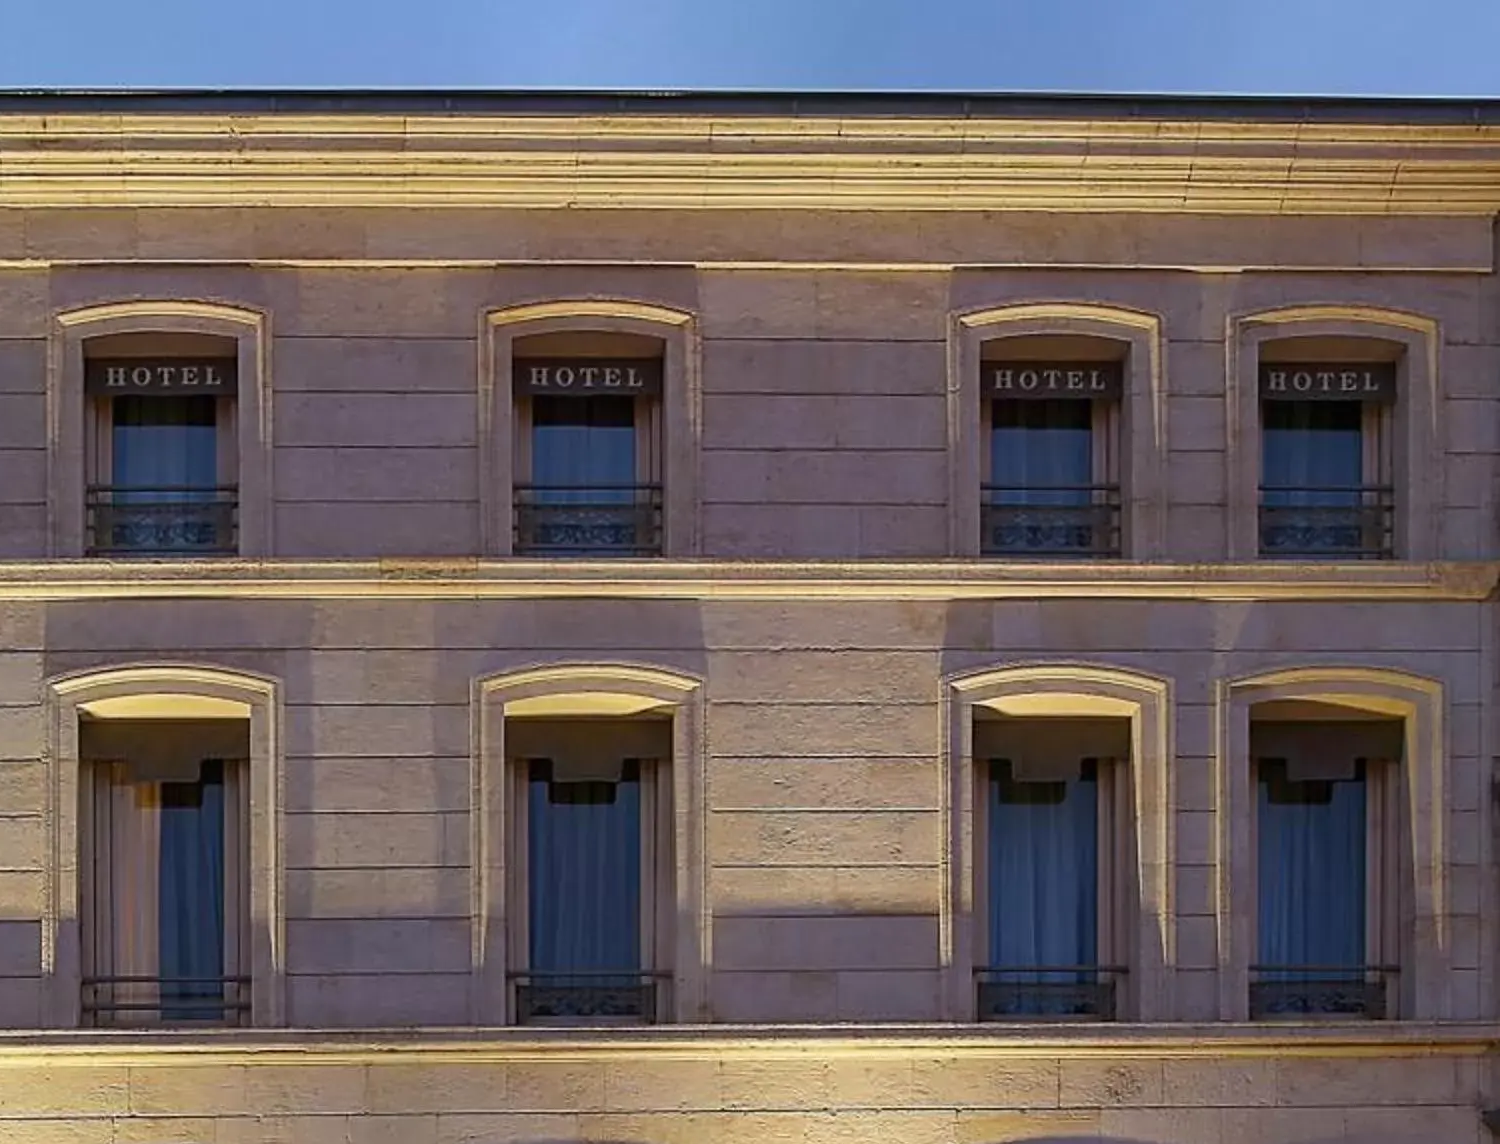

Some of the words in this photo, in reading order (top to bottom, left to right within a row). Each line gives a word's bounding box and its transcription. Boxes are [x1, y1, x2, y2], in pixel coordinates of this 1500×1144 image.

[106, 367, 221, 387] HOTEL
[530, 367, 644, 387] HOTEL
[995, 370, 1106, 390] HOTEL
[1268, 371, 1379, 392] HOTEL
